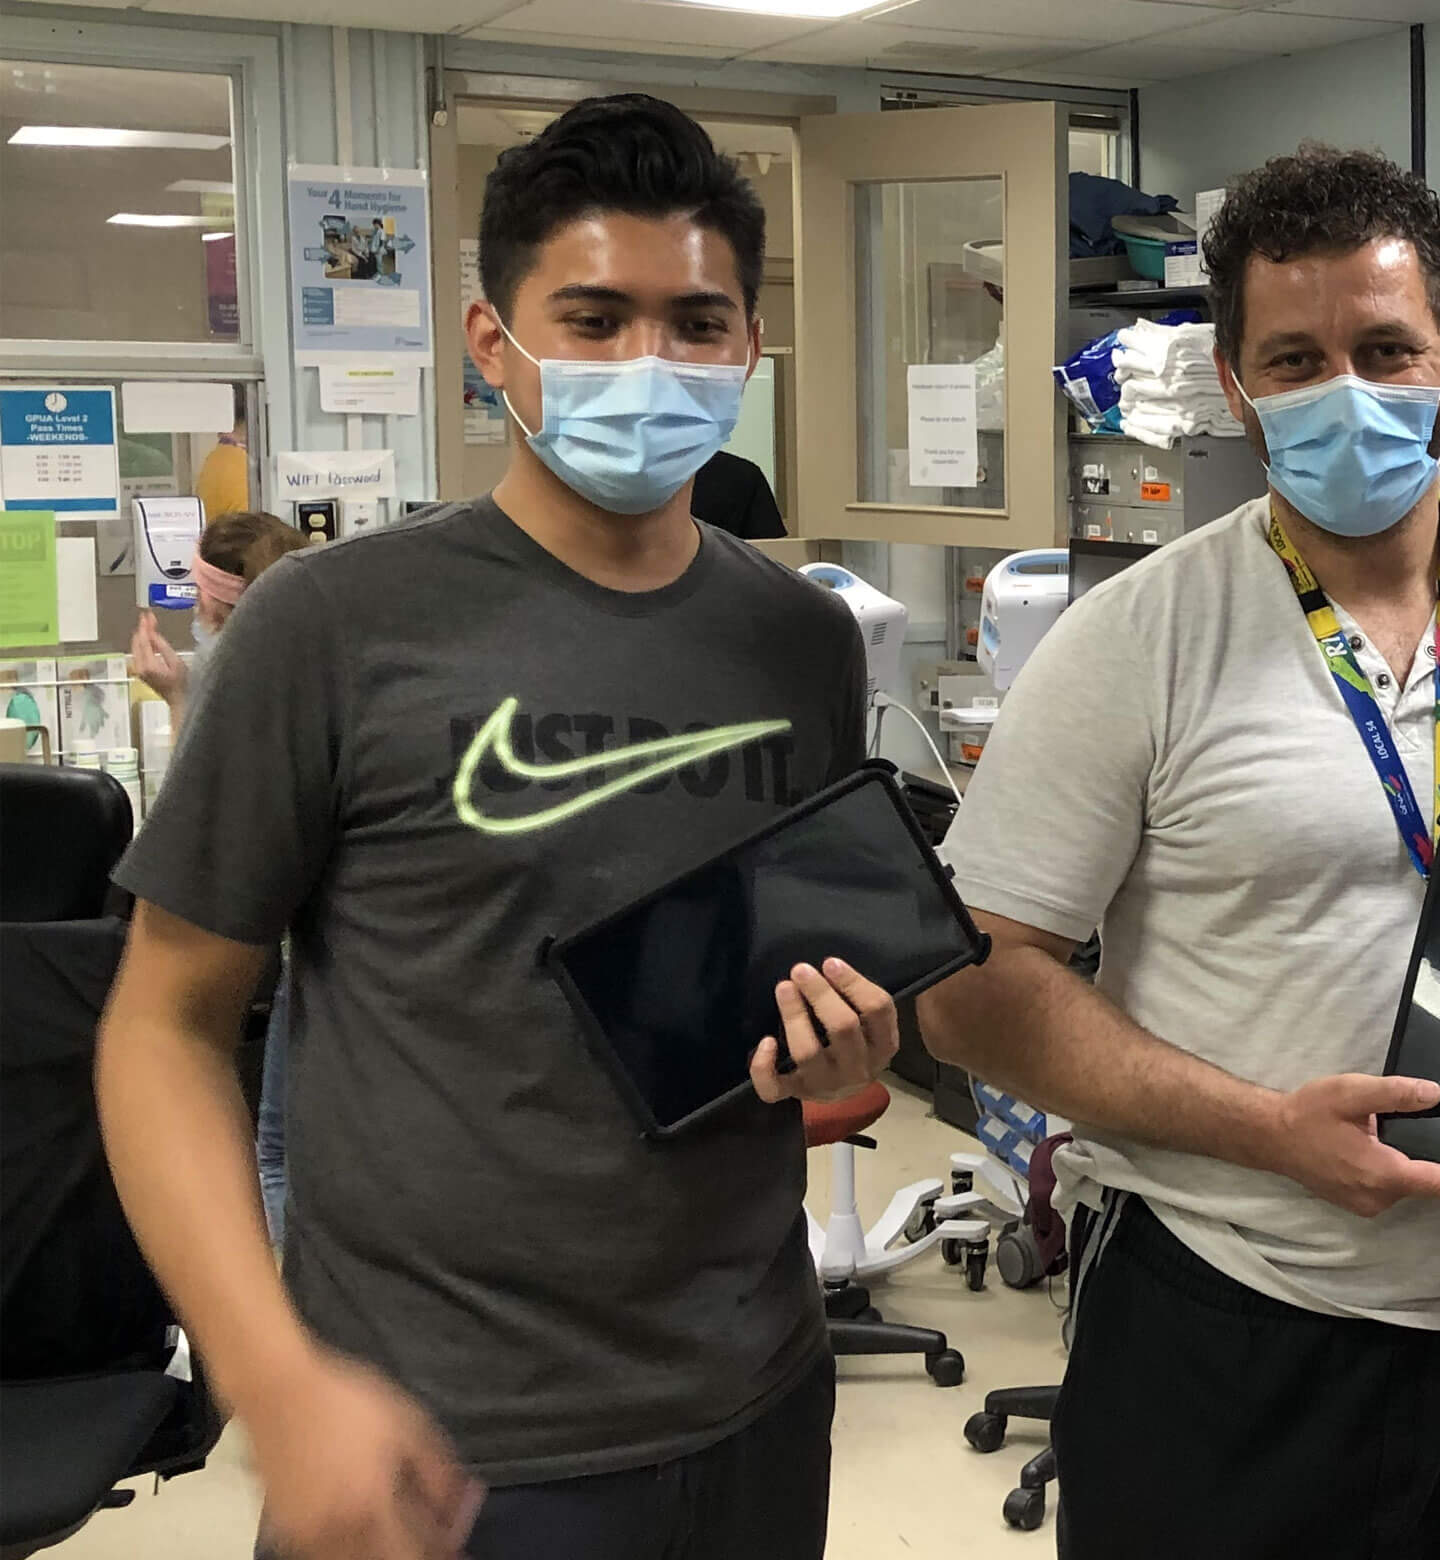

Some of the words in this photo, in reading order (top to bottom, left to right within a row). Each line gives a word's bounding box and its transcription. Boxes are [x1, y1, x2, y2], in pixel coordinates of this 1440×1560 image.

[307, 187, 328, 198] Your
[328, 189, 341, 209] 4
[344, 190, 386, 201] Moments
[388, 191, 402, 200] for
[344, 202, 369, 211] Hand
[370, 203, 407, 214] Hygiene
[25, 414, 53, 423] GPUA
[55, 414, 80, 423] Level
[82, 414, 88, 423] 2
[30, 424, 53, 432] Pass
[56, 424, 83, 432] Times
[26, 433, 88, 441] -WEEKENDS-
[286, 474, 319, 487] WIFI
[1365, 719, 1377, 733] 54
[1370, 731, 1389, 760] LOCAL
[629, 717, 730, 798] DO
[744, 724, 796, 806] IT
